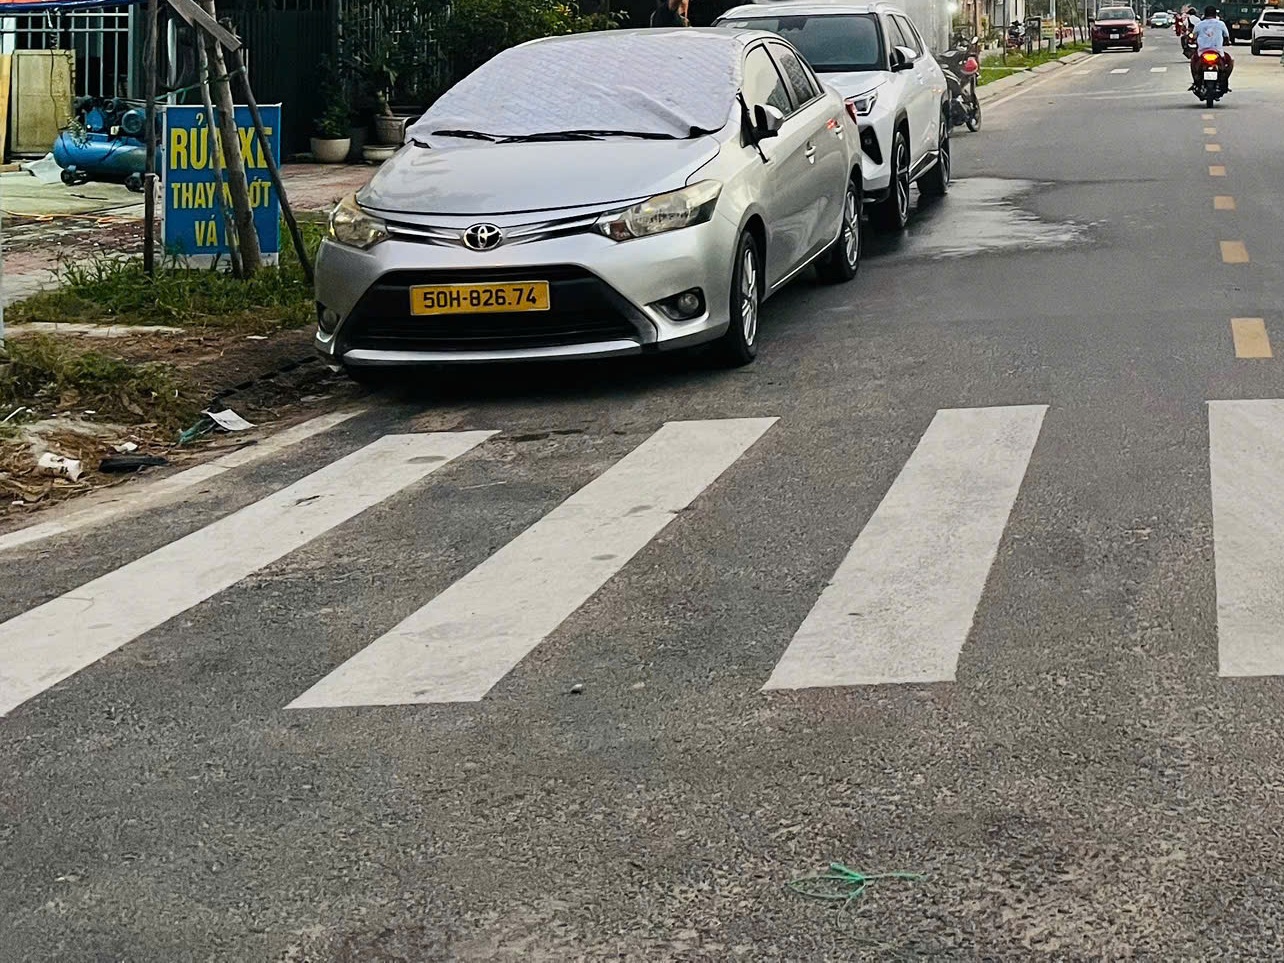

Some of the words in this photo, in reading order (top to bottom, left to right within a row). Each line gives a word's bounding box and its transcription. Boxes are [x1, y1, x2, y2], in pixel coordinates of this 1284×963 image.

[171, 181, 216, 209] THAY
[222, 175, 272, 209] NỚT
[194, 213, 218, 247] VÁ
[423, 287, 537, 309] 50H-826.74
